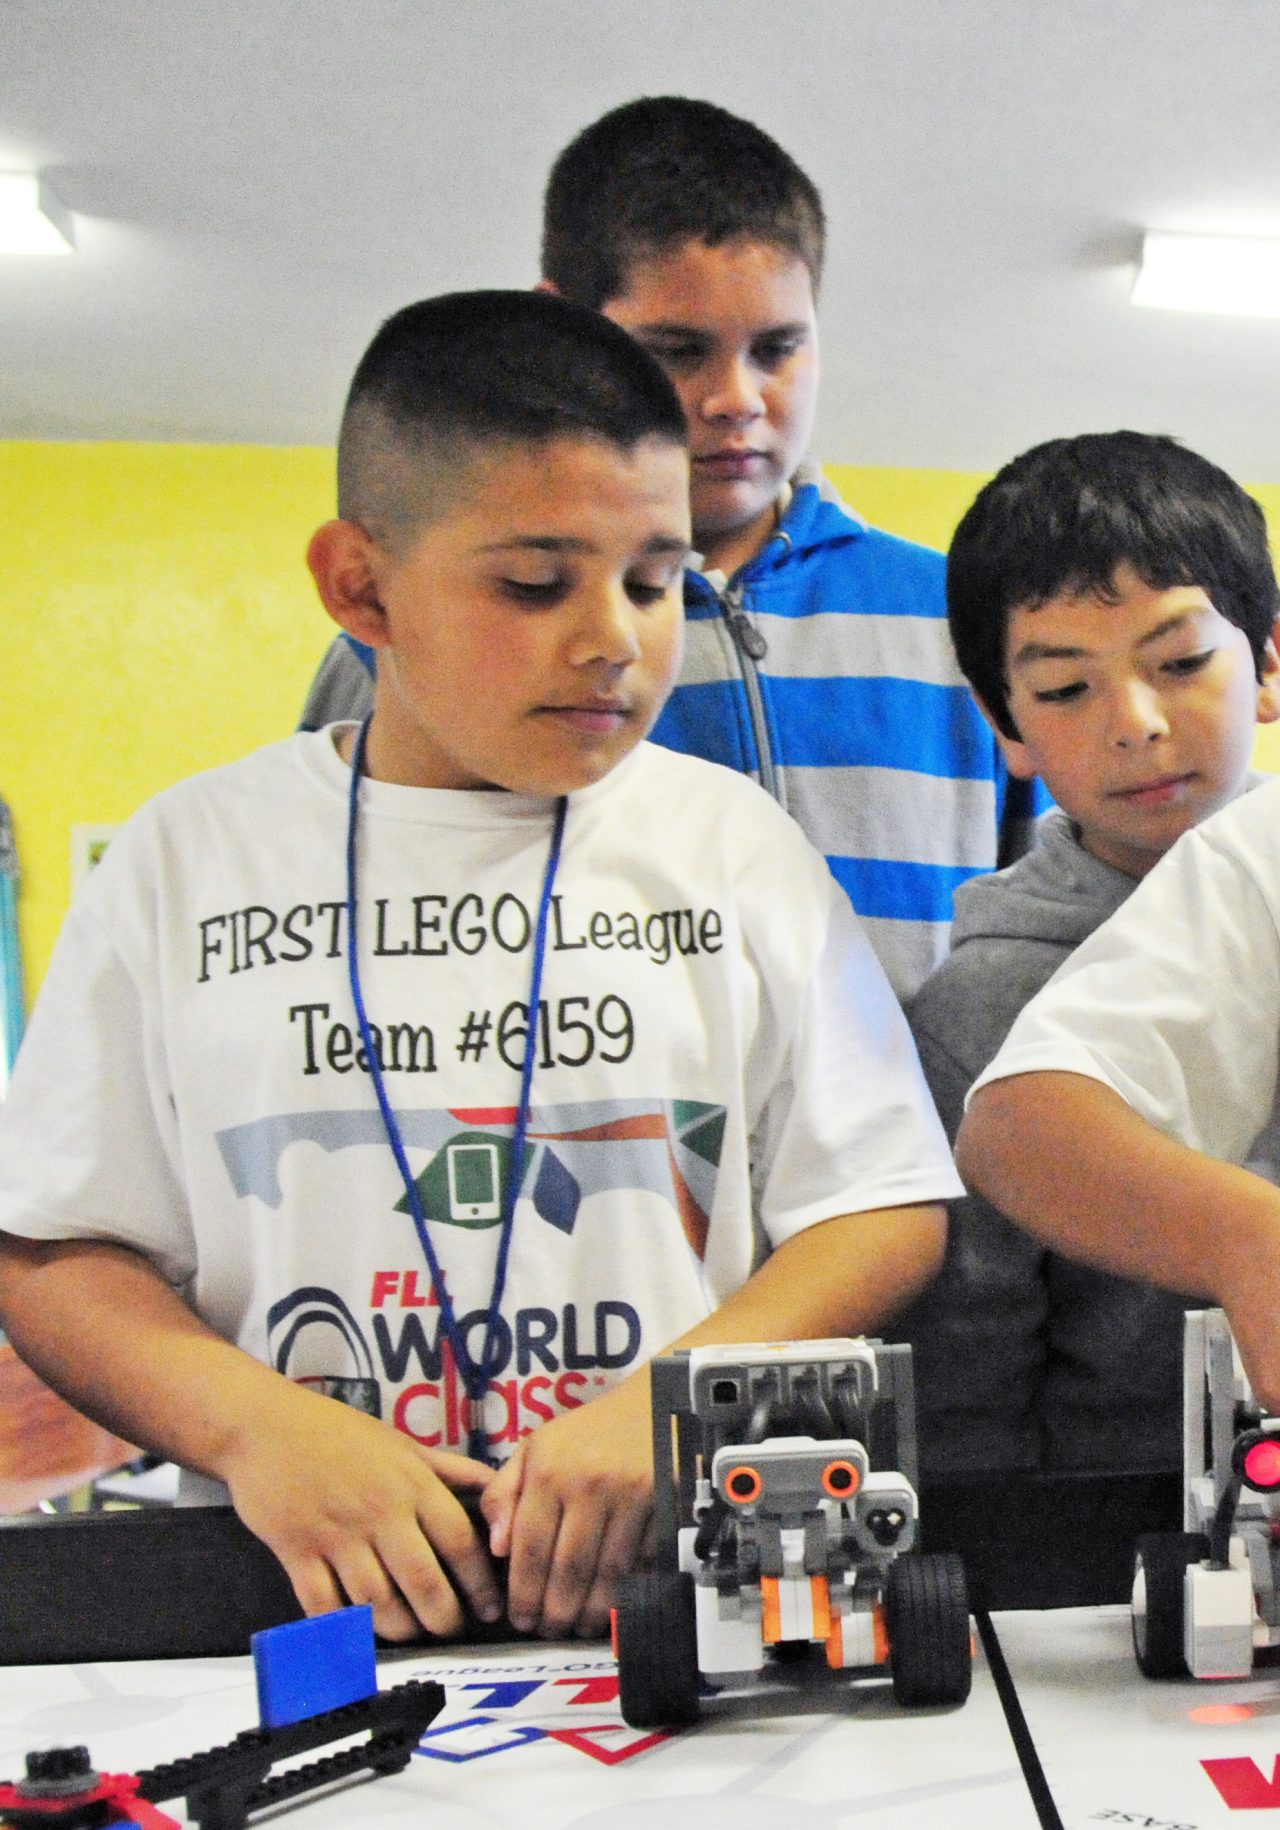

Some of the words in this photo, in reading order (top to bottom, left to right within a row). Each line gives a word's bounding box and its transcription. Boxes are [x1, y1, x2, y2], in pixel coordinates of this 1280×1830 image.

[197, 902, 350, 983] FIRST
[373, 892, 531, 955] LEGO
[549, 895, 724, 965] League
[289, 1003, 437, 1075] Team
[455, 994, 635, 1073] #6159
[372, 1300, 642, 1383] WORLD
